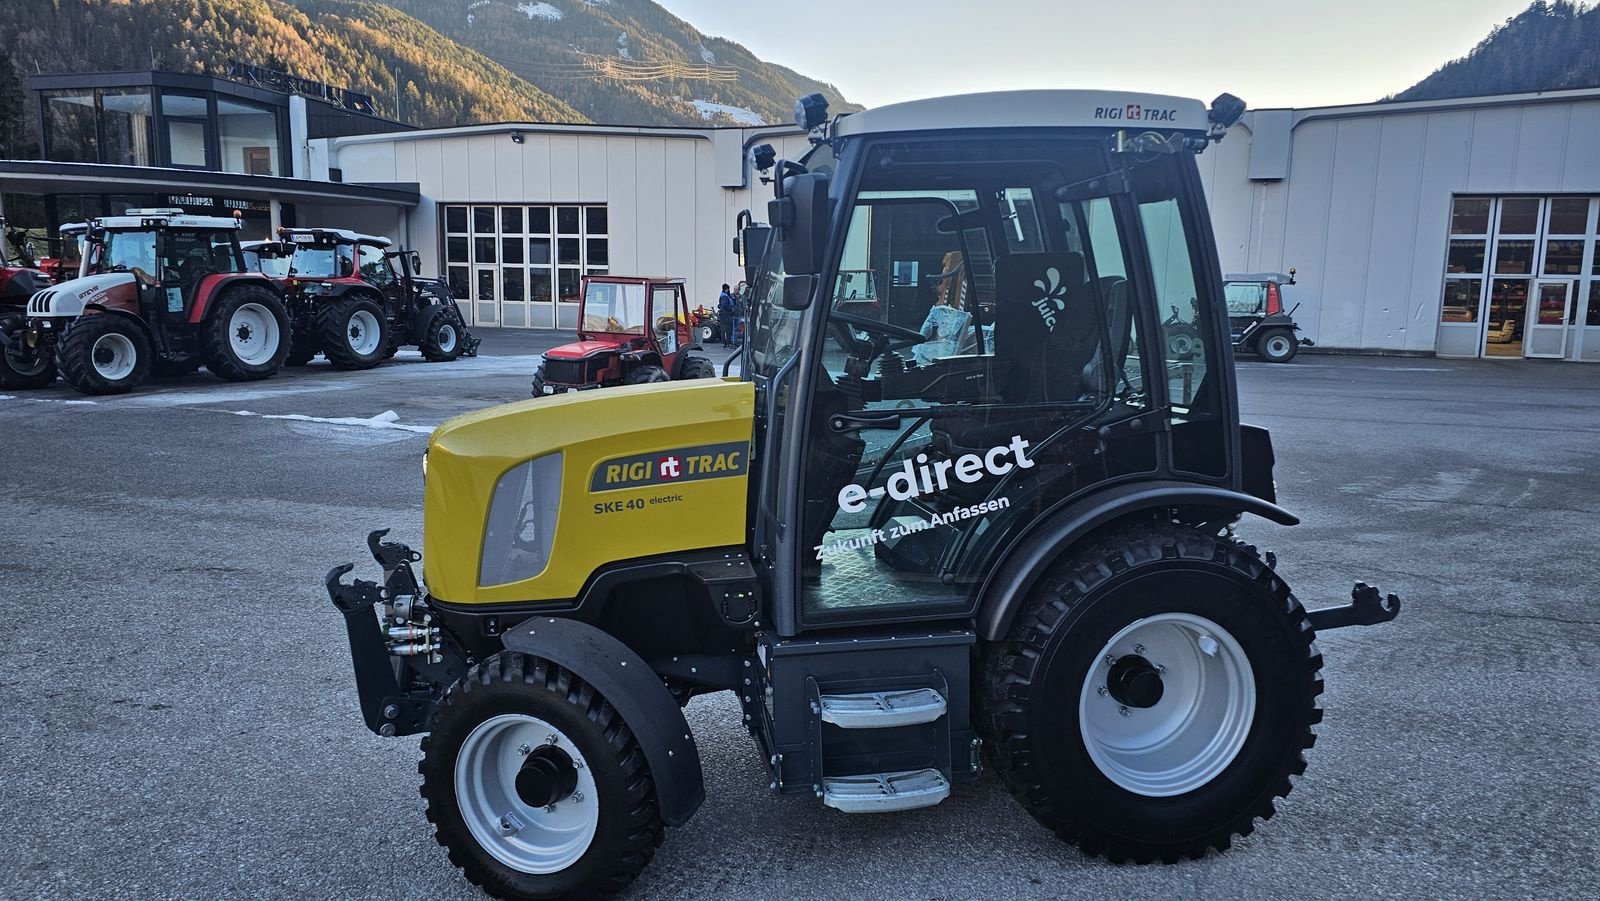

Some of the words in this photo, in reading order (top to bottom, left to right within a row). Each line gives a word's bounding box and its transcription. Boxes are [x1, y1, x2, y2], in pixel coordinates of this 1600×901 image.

[1095, 107, 1123, 119] RIGI
[1144, 109, 1177, 121] TRAC
[606, 461, 652, 483] RIGI
[686, 452, 741, 475] TRAC
[838, 435, 1035, 513] e-direct
[594, 501, 624, 515] SKE
[626, 498, 645, 510] 40
[649, 494, 683, 505] electric
[813, 527, 887, 561] Zukunft
[890, 517, 932, 540] zum
[931, 495, 1010, 527] Anfassen
